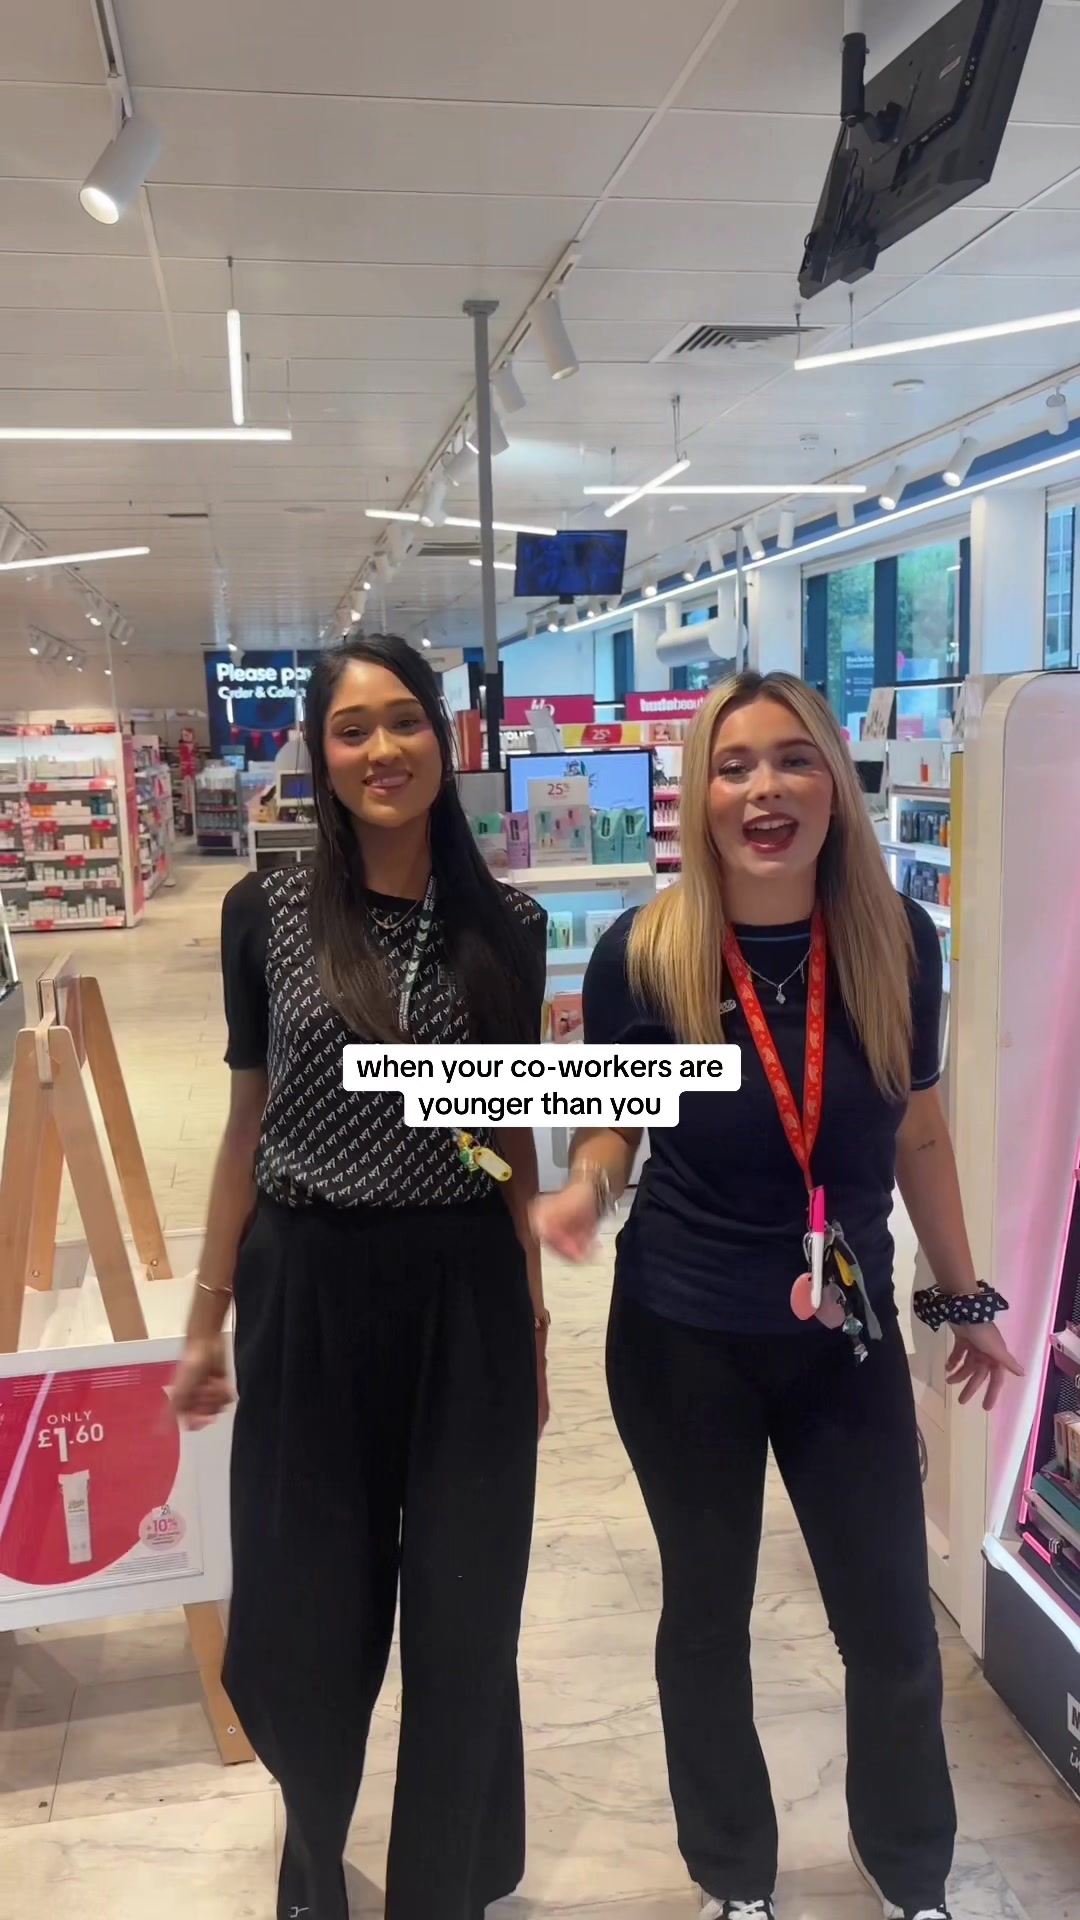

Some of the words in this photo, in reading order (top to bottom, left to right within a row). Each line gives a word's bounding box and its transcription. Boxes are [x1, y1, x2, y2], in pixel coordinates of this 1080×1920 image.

[216, 662, 277, 682] Please
[47, 1410, 93, 1425] ONLY
[38, 1423, 104, 1462] £1.60
